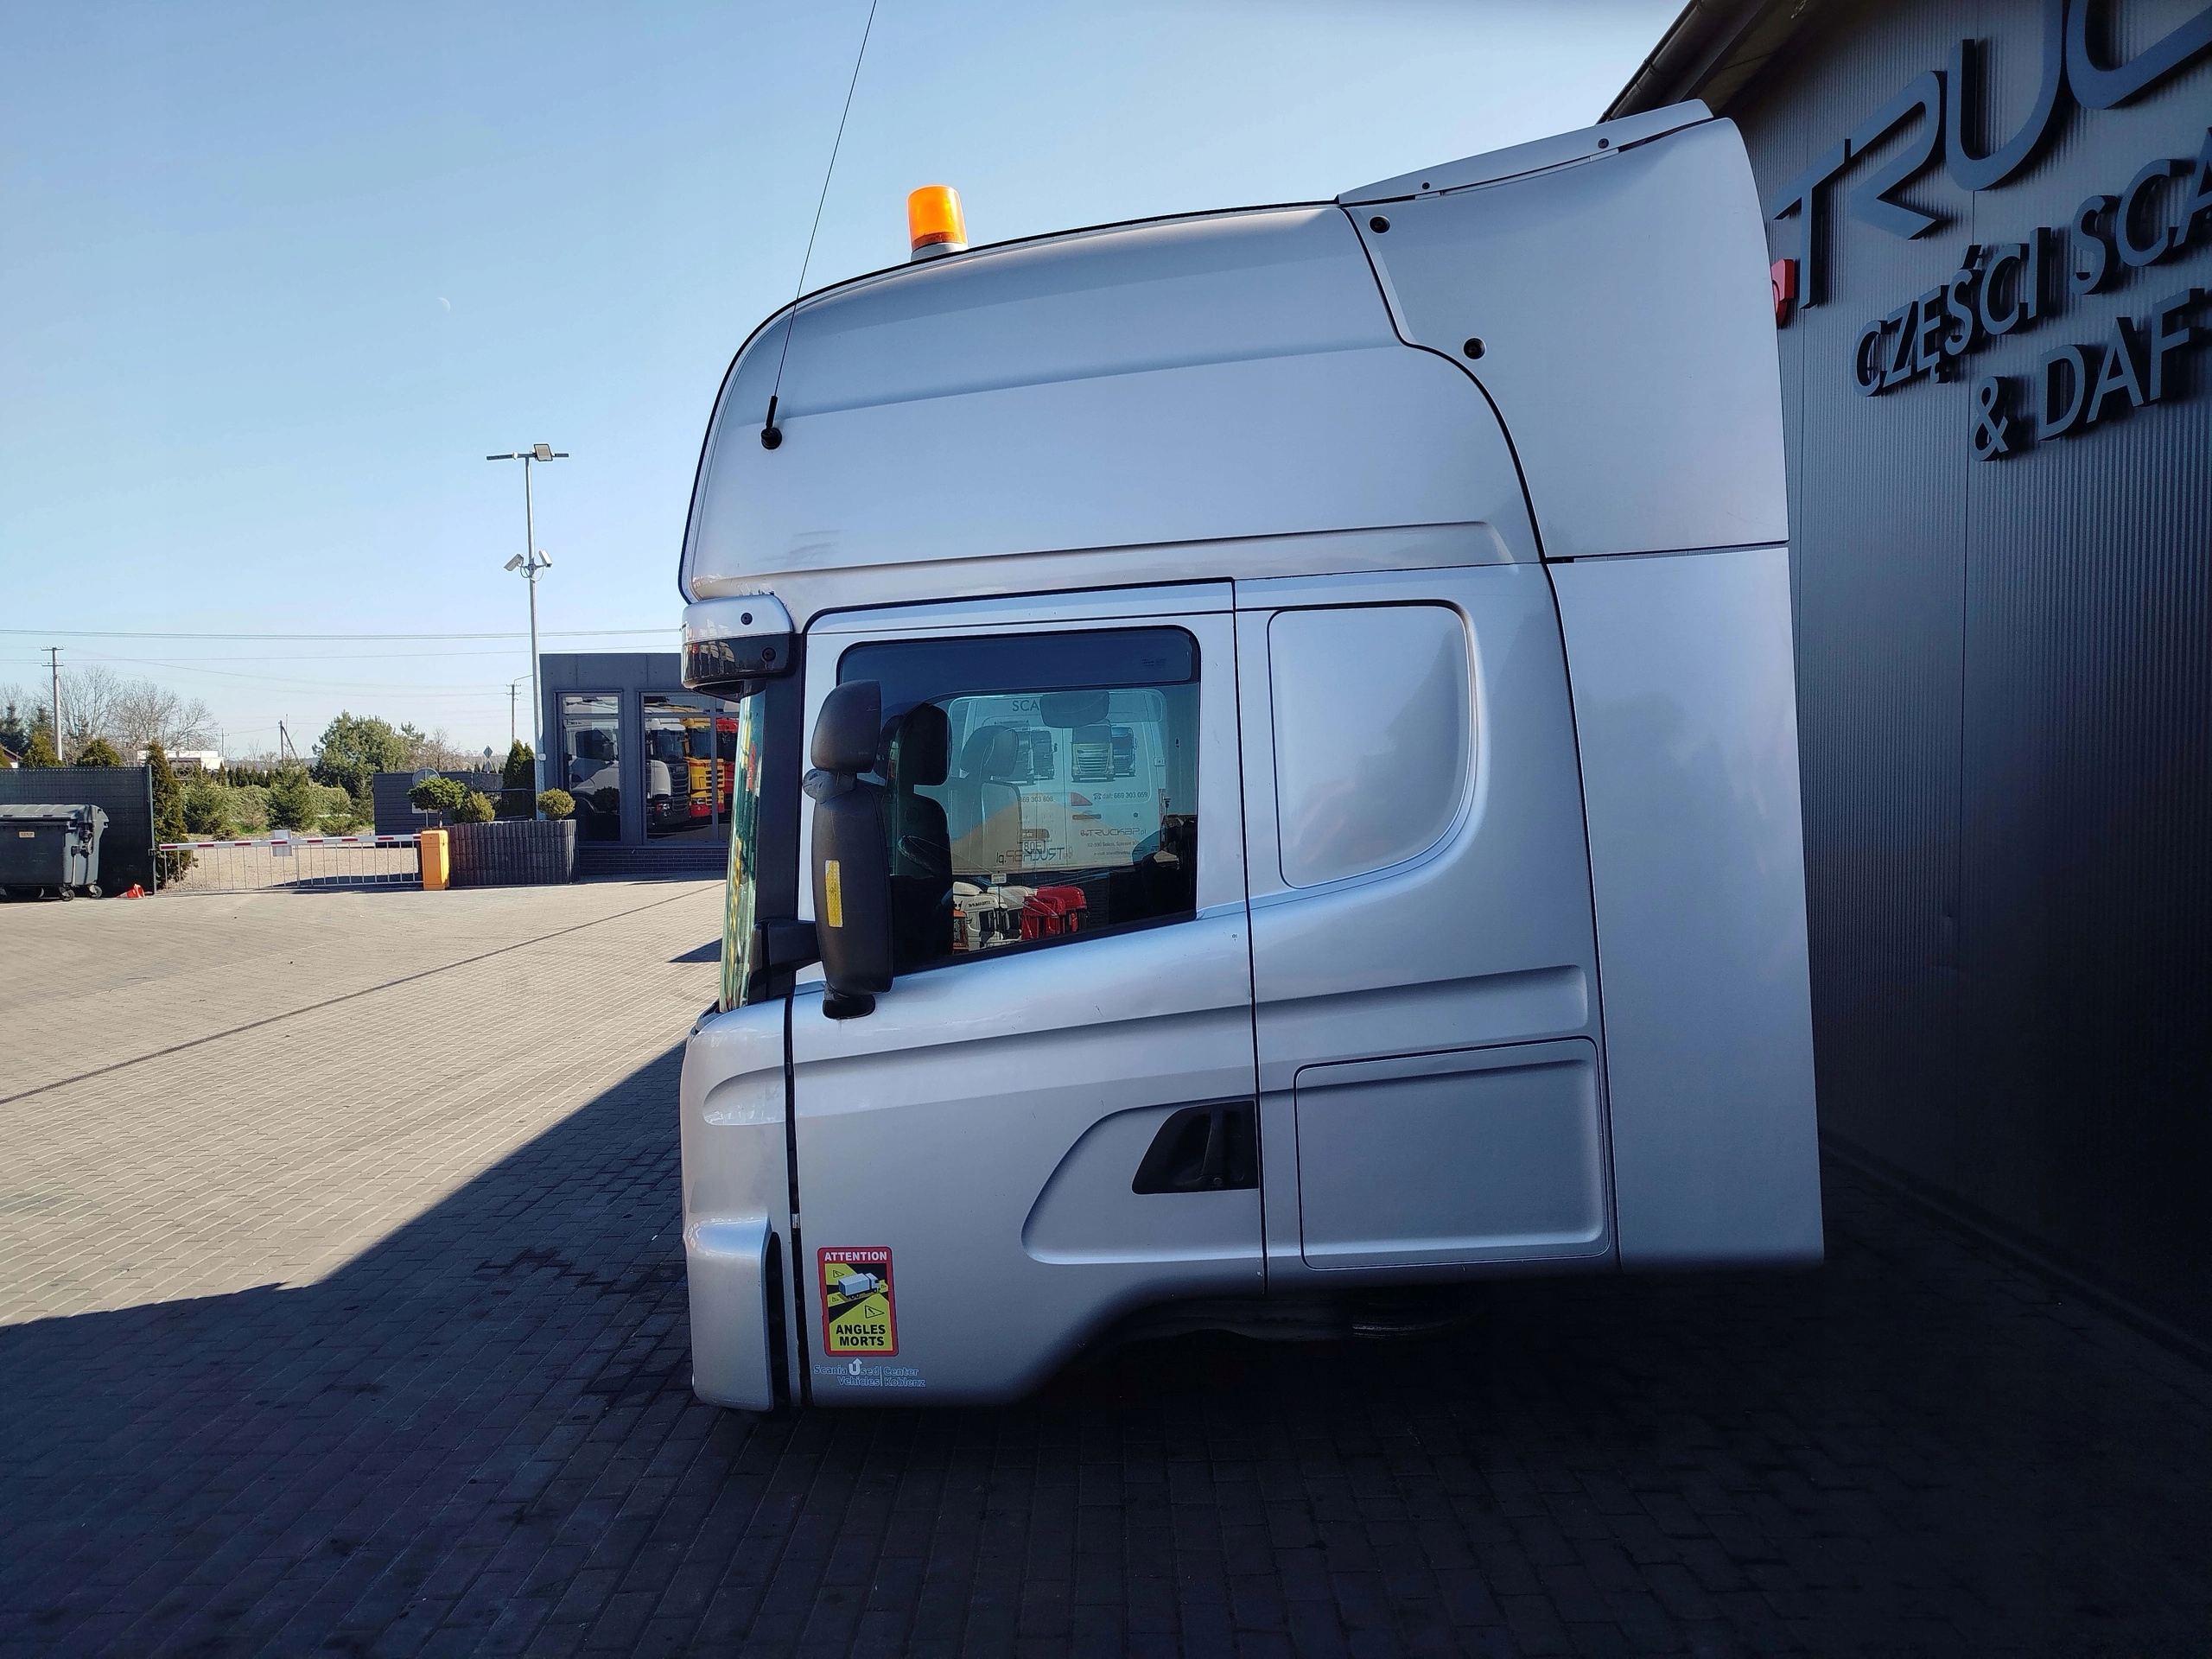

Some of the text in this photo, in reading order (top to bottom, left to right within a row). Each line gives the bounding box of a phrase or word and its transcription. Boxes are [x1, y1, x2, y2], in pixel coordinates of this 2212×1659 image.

[1852, 227, 2051, 397] CZĘŚCI
[1972, 289, 2205, 461] & DAF
[824, 1251, 887, 1262] ATTENTION
[836, 1324, 886, 1335] ANGLES
[839, 1336, 885, 1346] MORTS
[813, 1358, 919, 1376] Scania Used Center
[837, 1376, 926, 1387] Vehicles Koblenz
